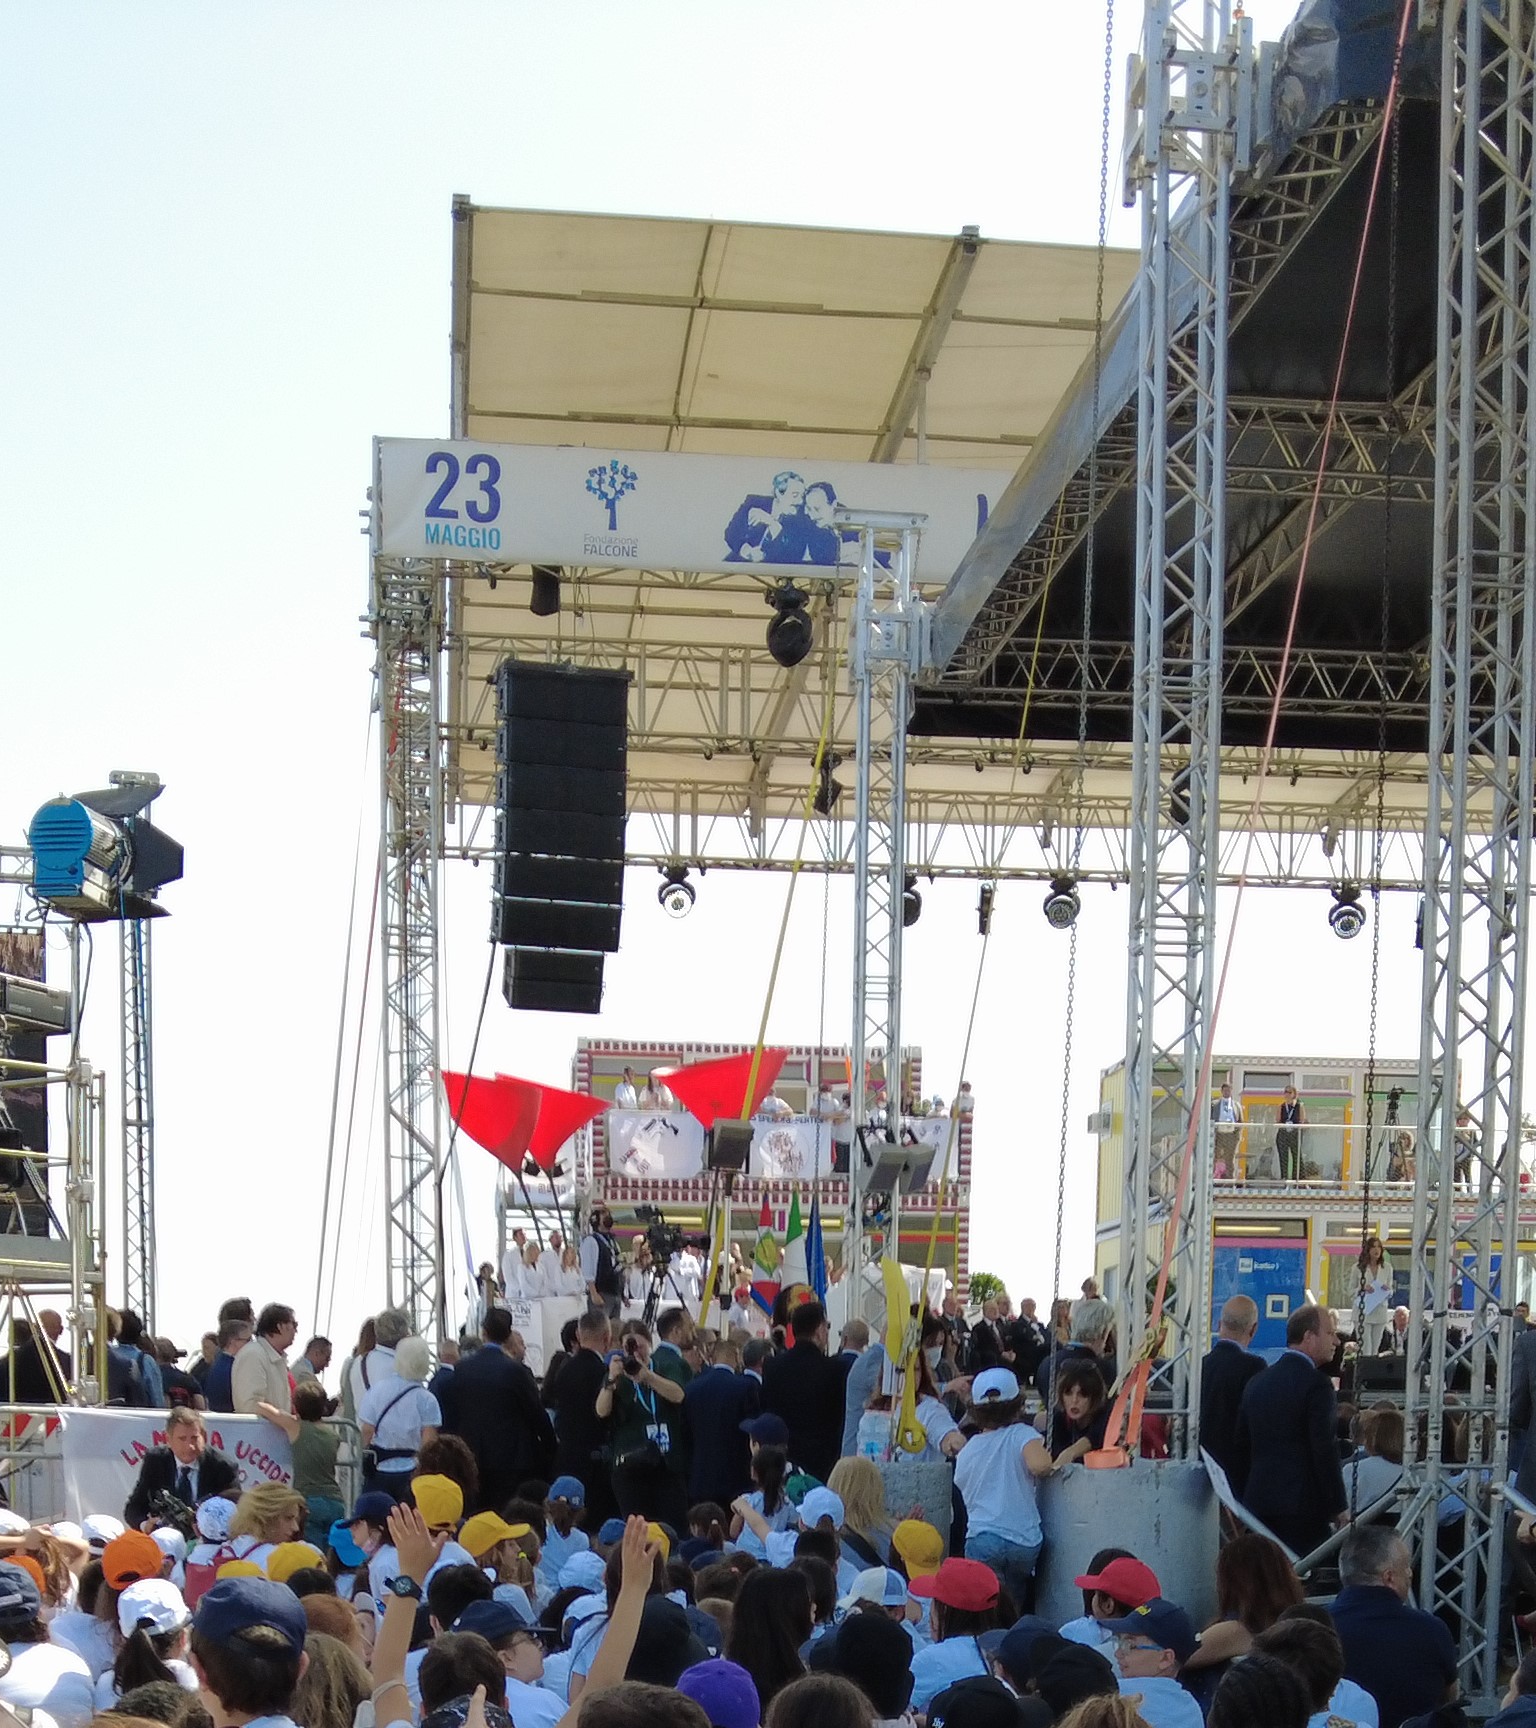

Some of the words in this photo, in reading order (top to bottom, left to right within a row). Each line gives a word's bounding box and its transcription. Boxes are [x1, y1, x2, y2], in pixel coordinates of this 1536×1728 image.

[424, 450, 502, 524] 23
[424, 522, 502, 551] MAGGIO
[583, 532, 639, 548] Fondazione
[583, 544, 639, 558] FALCONE
[120, 1440, 148, 1466] LA
[235, 1439, 292, 1484] UCCIDE
